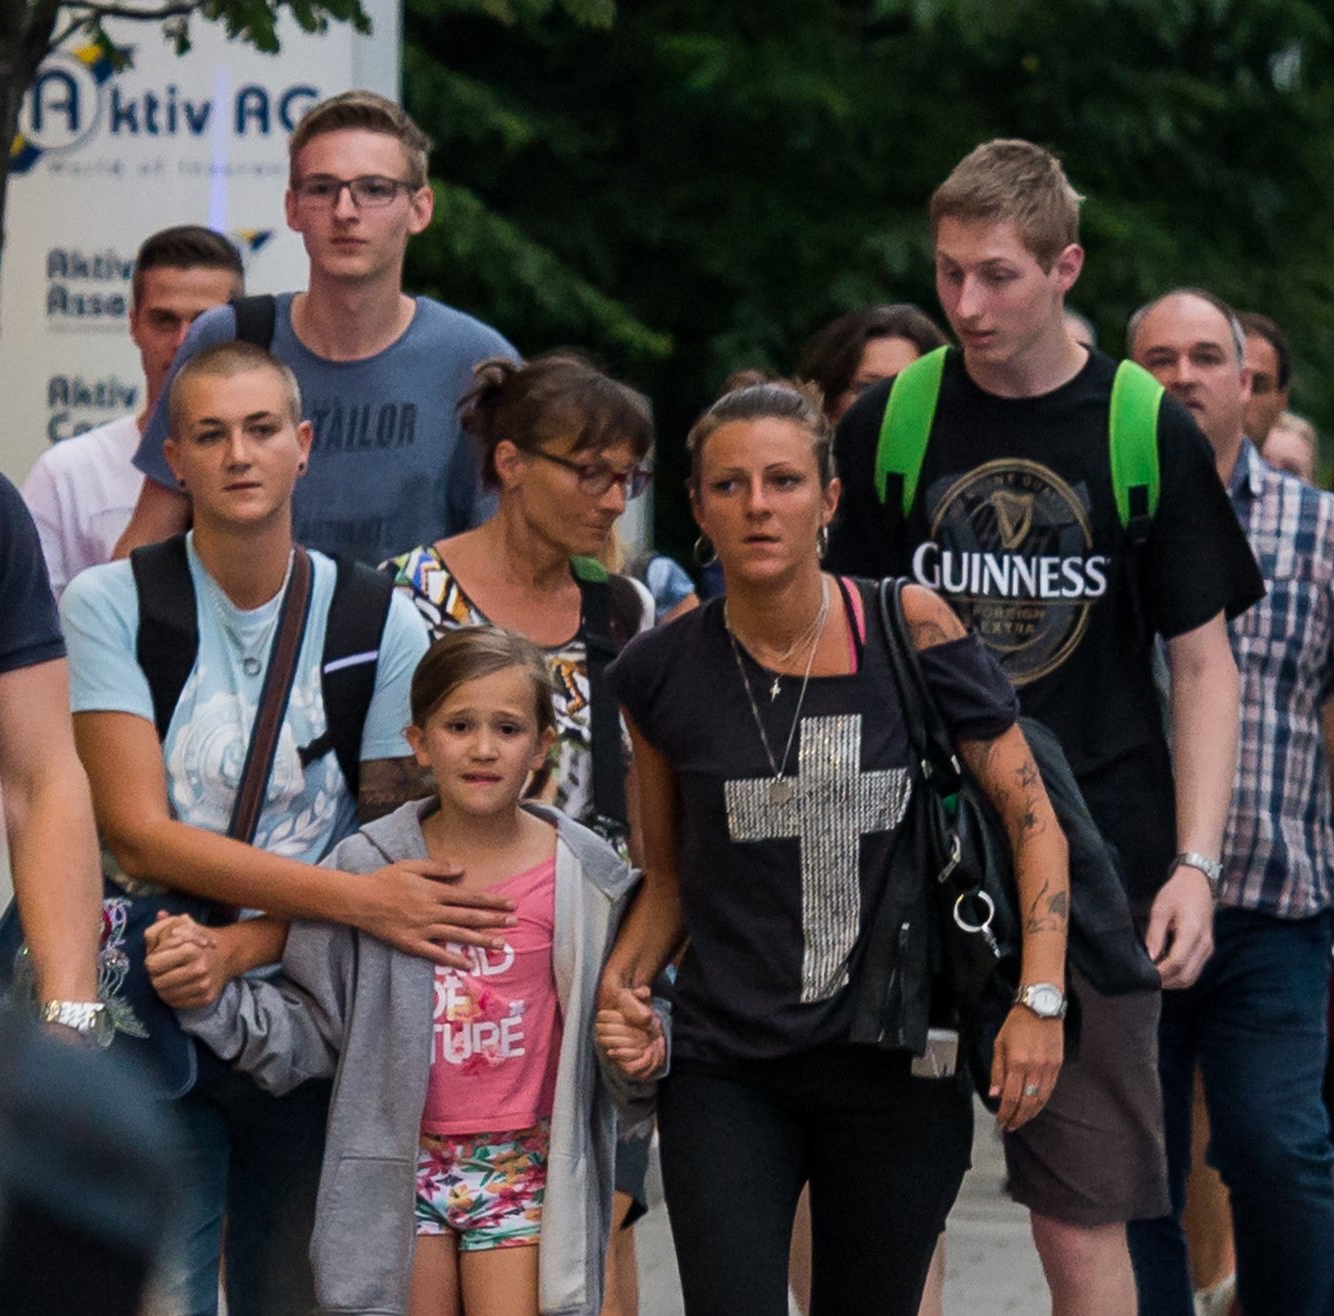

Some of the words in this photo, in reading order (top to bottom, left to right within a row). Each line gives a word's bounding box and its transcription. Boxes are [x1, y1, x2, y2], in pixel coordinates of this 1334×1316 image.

[30, 68, 212, 135] Aktiv
[46, 247, 136, 281] Aktiv
[47, 374, 138, 409] Aktiv
[310, 401, 417, 450] TAILOR
[912, 541, 1108, 599] GUINNESS
